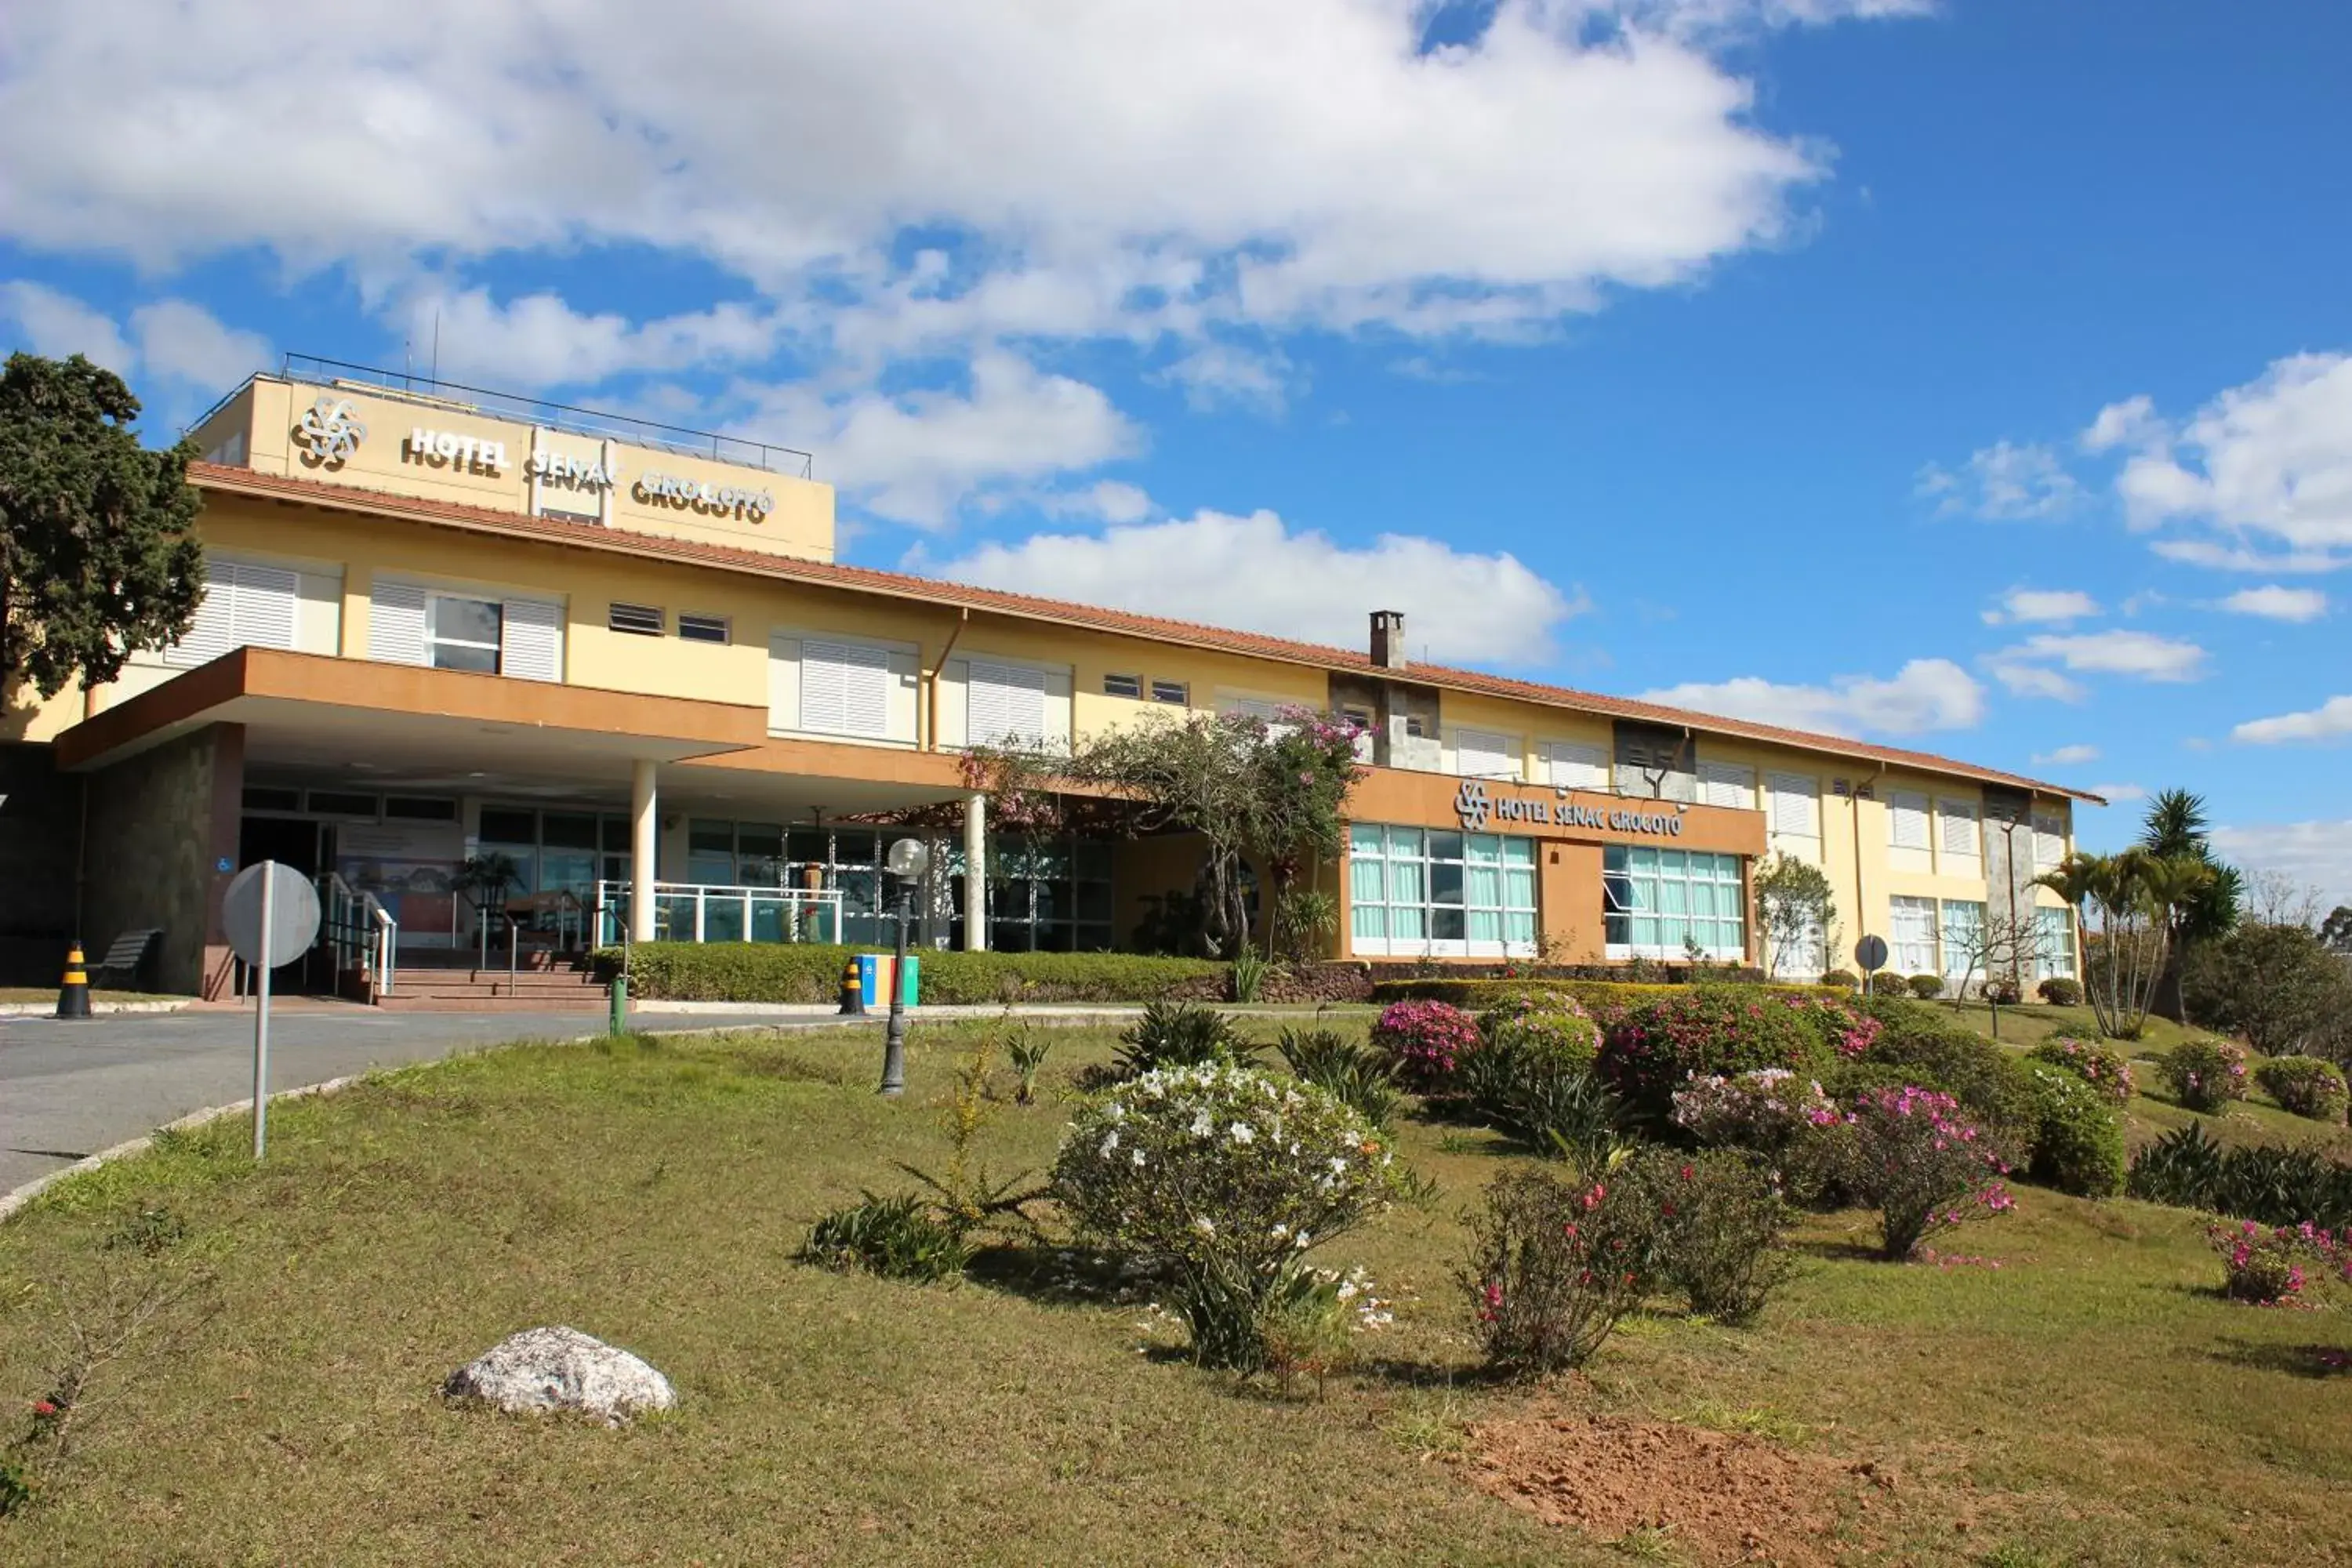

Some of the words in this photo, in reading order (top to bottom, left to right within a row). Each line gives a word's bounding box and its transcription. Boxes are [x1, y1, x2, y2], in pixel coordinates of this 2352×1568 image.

[412, 426, 512, 469] HOTEL
[1497, 798, 1548, 824] HOTEL
[1555, 804, 1604, 829] SENAC
